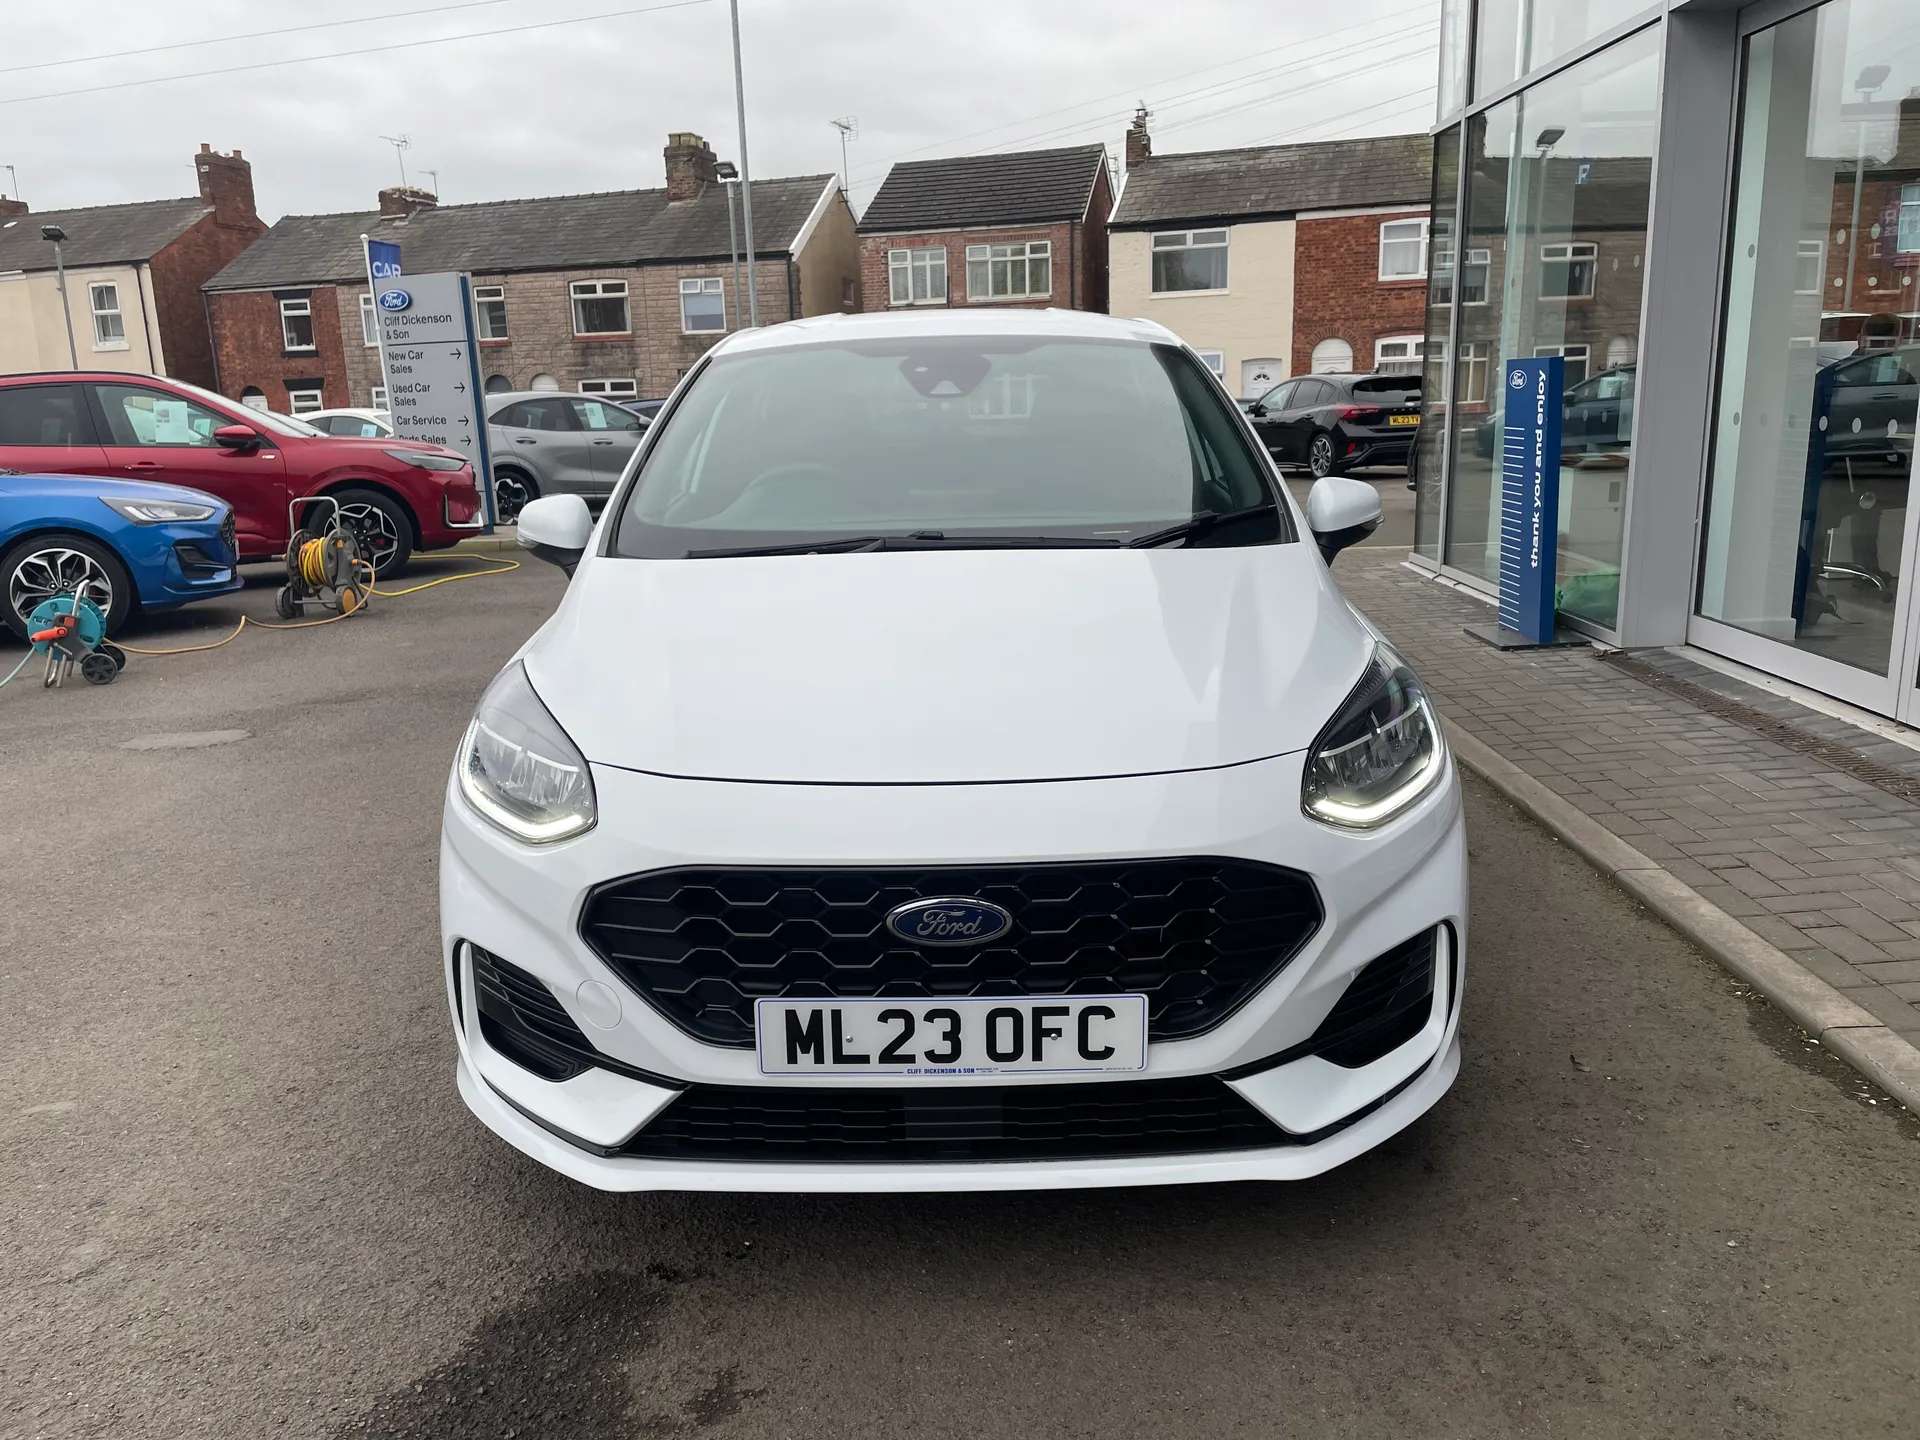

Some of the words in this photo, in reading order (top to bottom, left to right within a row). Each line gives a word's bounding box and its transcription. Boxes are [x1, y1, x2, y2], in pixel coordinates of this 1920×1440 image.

[372, 261, 401, 278] CAR
[383, 293, 403, 308] Ford
[384, 315, 400, 327] Cliff
[401, 314, 452, 325] Dickenson
[386, 330, 392, 340] &
[393, 328, 410, 340] Son
[388, 351, 407, 361] New
[407, 350, 424, 360] Car
[390, 364, 413, 375] Sales
[392, 383, 413, 394] Used
[414, 382, 431, 393] Car
[394, 396, 417, 407] Sales
[1537, 369, 1546, 426] enjoy
[396, 415, 411, 425] Car
[412, 415, 447, 425] Service
[421, 434, 447, 445] Sales
[1535, 429, 1543, 469] and
[1531, 512, 1540, 568] thank
[916, 909, 983, 936] Ford
[784, 1008, 962, 1064] ML23
[985, 1005, 1116, 1063] OFC
